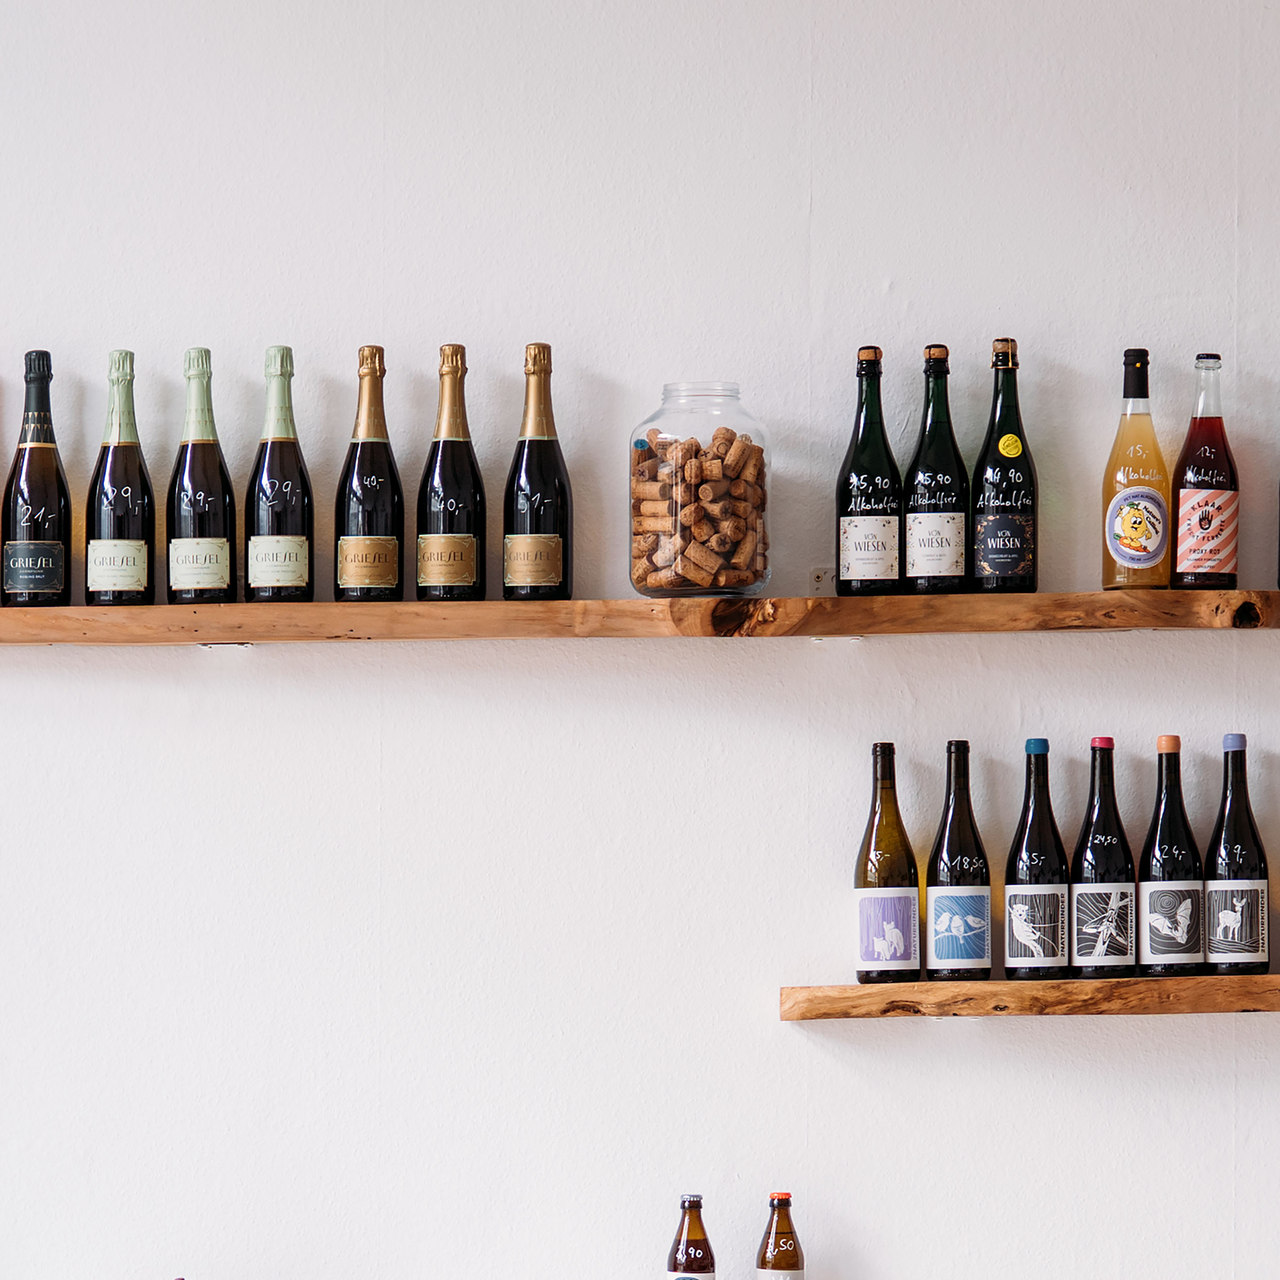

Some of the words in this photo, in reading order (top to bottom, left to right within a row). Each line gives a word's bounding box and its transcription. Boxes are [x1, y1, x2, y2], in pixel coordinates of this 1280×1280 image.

[1126, 444, 1150, 459] 15,-
[1196, 445, 1216, 460] 12,-
[363, 475, 385, 490] 40,-
[103, 486, 143, 516] 29,-
[848, 496, 899, 512] Alkoholfrei
[908, 492, 957, 509] Alkoholfrei
[976, 490, 1032, 509] Alkoholfrei
[1190, 500, 1223, 511] KLAAR
[21, 505, 56, 528] 21,-
[854, 541, 888, 551] WIESEN
[919, 537, 951, 548] WIESEN
[987, 538, 1021, 548] WIESEN
[1093, 834, 1118, 846] 24,50
[952, 855, 984, 872] 18,50
